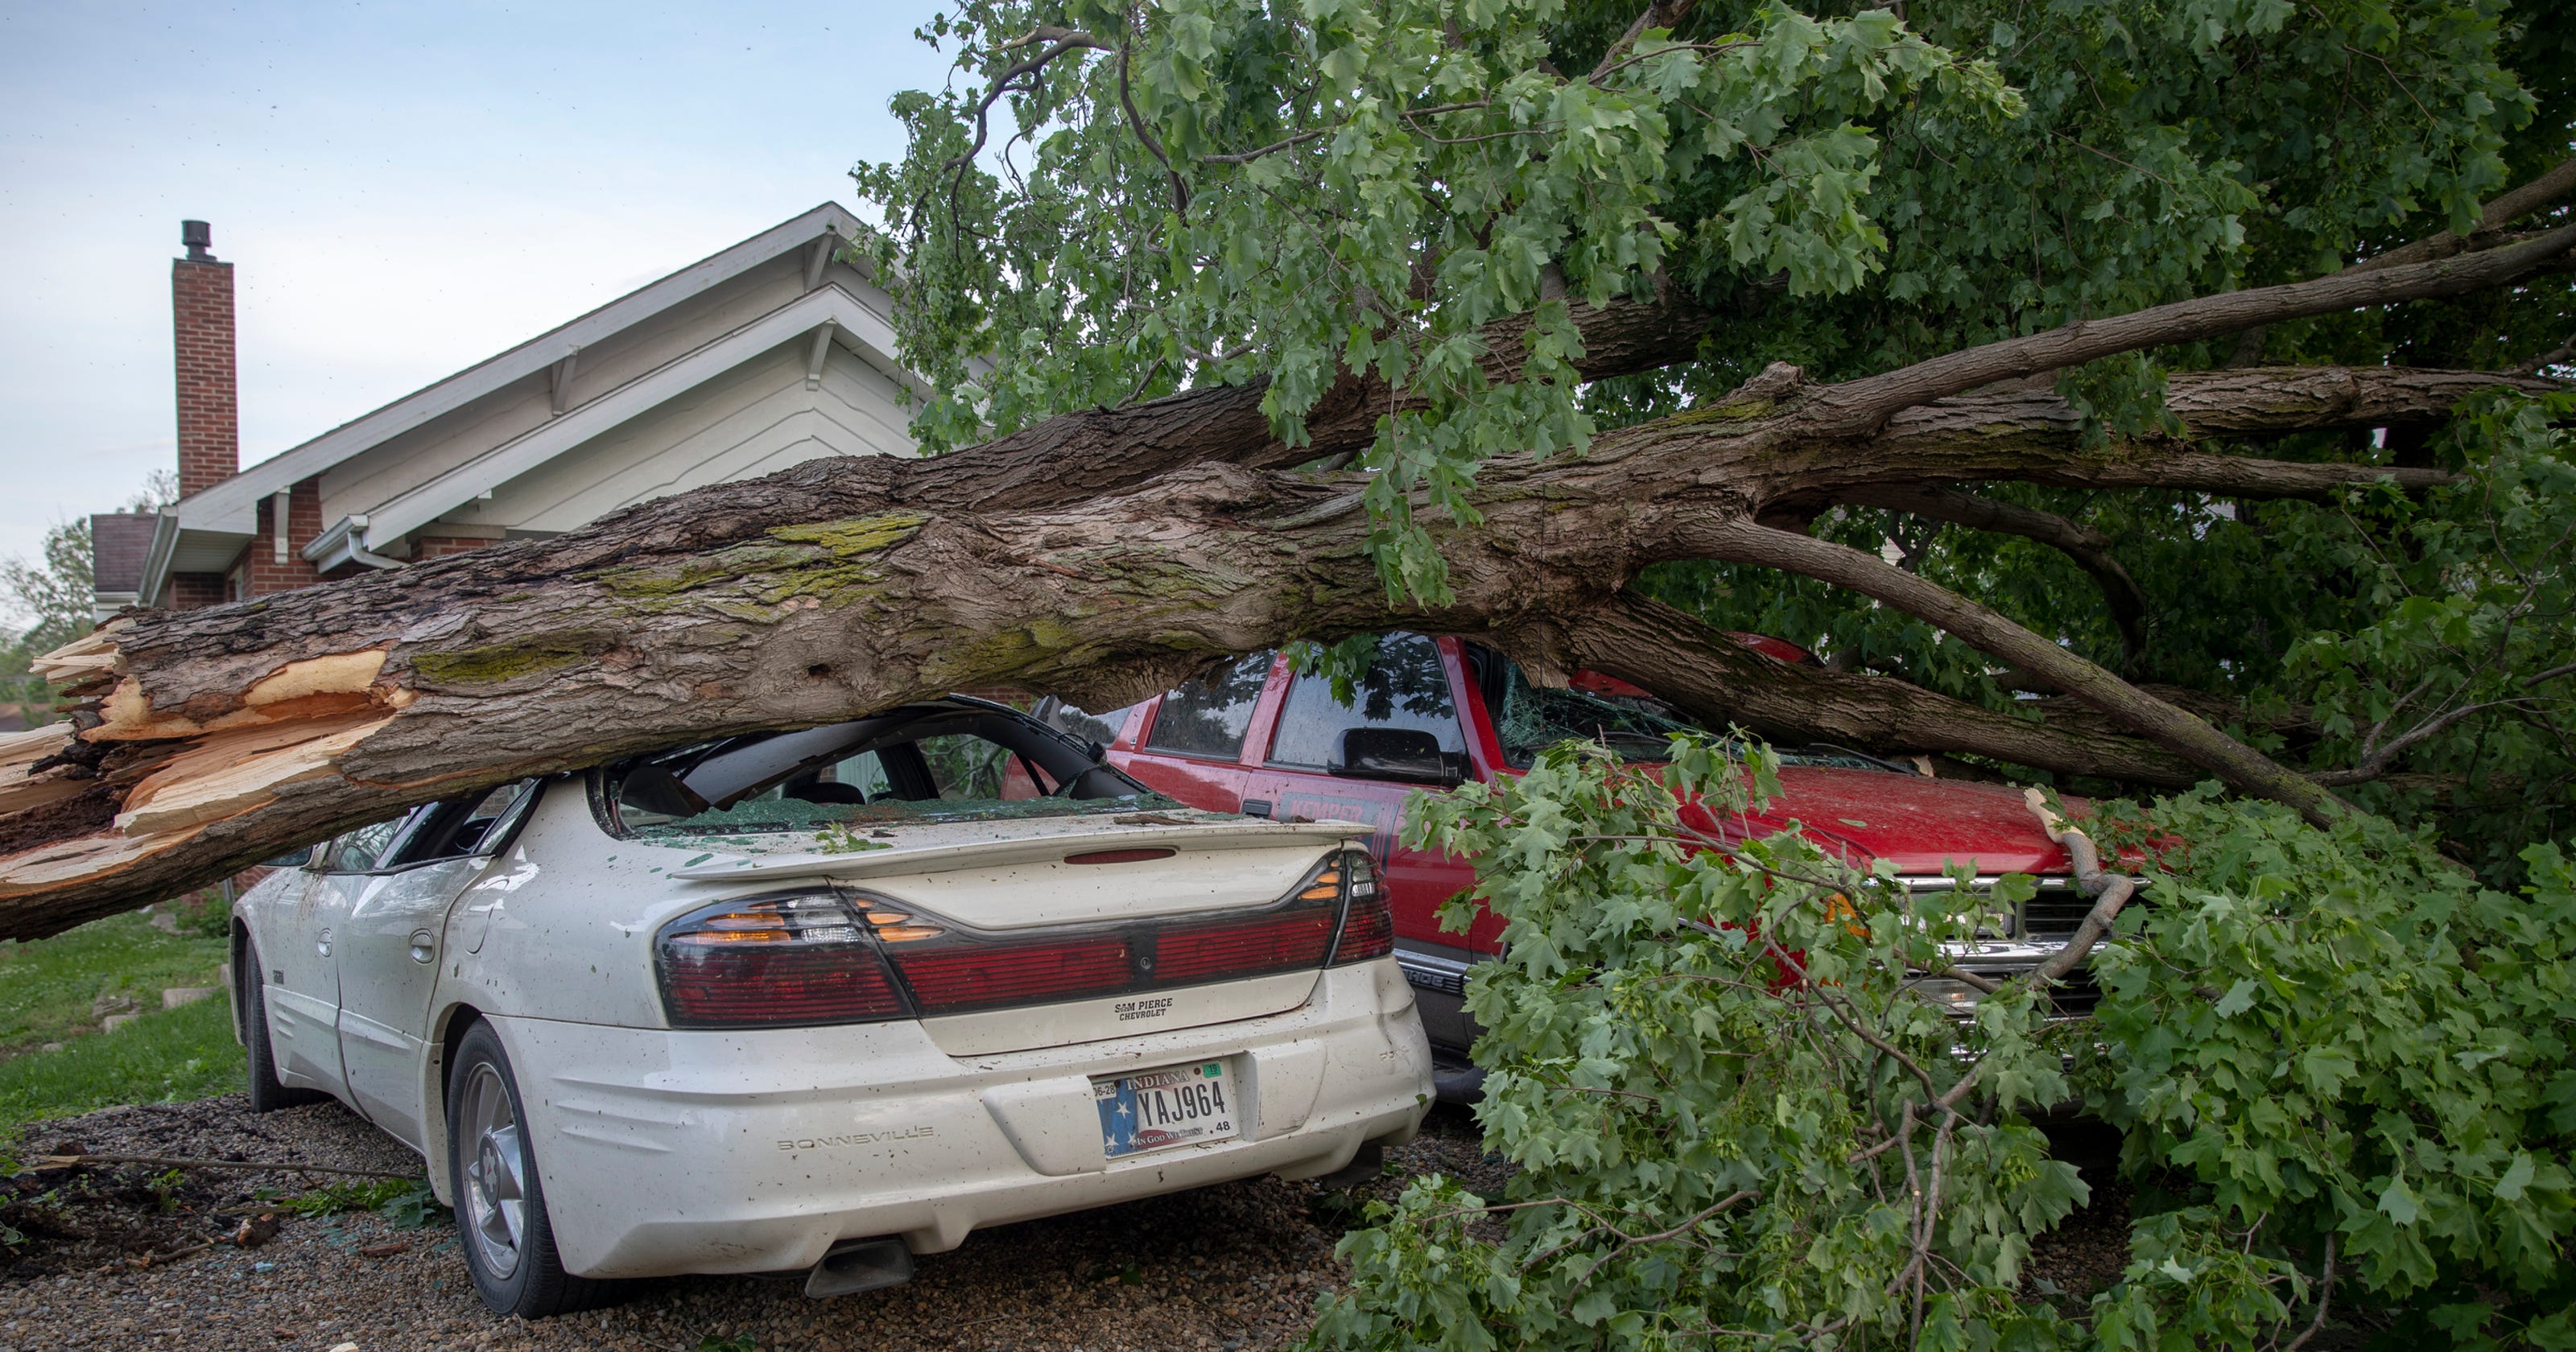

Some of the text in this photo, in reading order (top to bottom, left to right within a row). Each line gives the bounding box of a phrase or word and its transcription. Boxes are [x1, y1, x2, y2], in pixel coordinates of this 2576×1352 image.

[1290, 798, 1364, 822] KEMPER
[1115, 998, 1173, 1012] SAM PIERCE
[1120, 1008, 1166, 1020] CHEVROLET
[1209, 1064, 1217, 1073] 19
[1127, 1070, 1190, 1090] INDIANA
[1137, 1081, 1225, 1127] YAJ964
[1216, 1121, 1230, 1131] 48
[777, 1126, 934, 1151] BONNEVILLE
